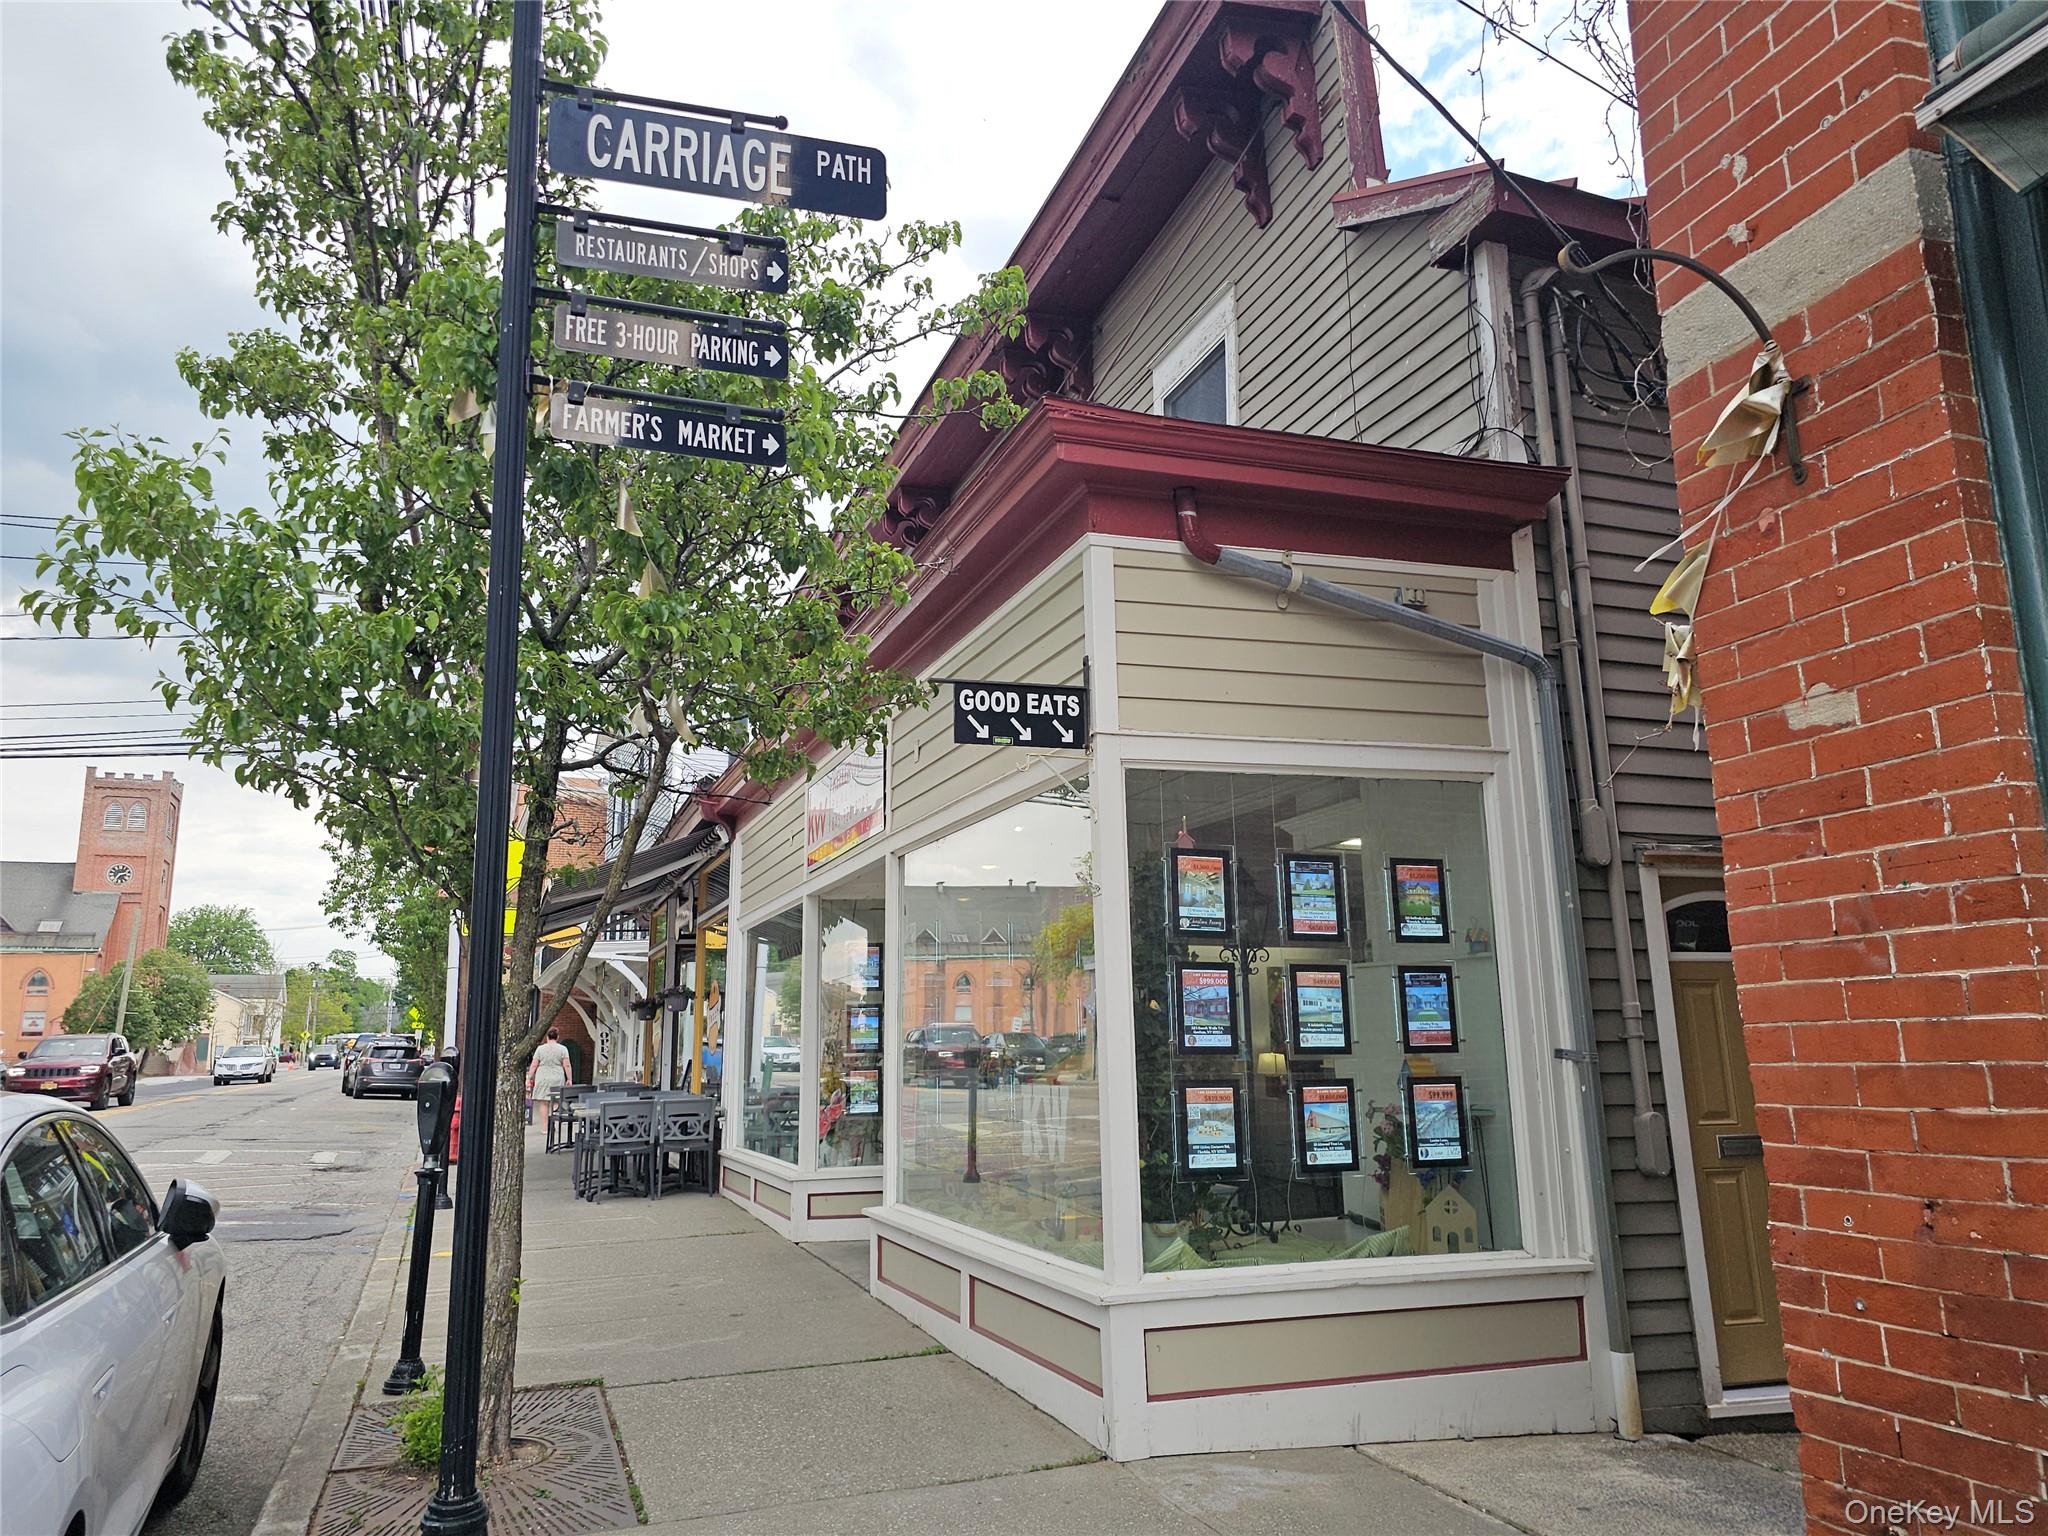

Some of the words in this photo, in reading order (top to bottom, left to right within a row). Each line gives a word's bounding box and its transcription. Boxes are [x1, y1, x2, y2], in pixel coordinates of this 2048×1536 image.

[586, 113, 792, 197] CARRIAGE
[816, 150, 872, 185] PATH
[565, 314, 607, 346] FREE
[615, 321, 678, 357] 3-HOUR
[690, 332, 759, 367] PARKING
[562, 404, 663, 443] FARMER'S
[677, 419, 756, 455] MARKET
[959, 689, 1020, 713] GOOD
[1026, 693, 1080, 717] EATS
[1199, 977, 1228, 985] $999,000
[1022, 1085, 1069, 1163] KW
